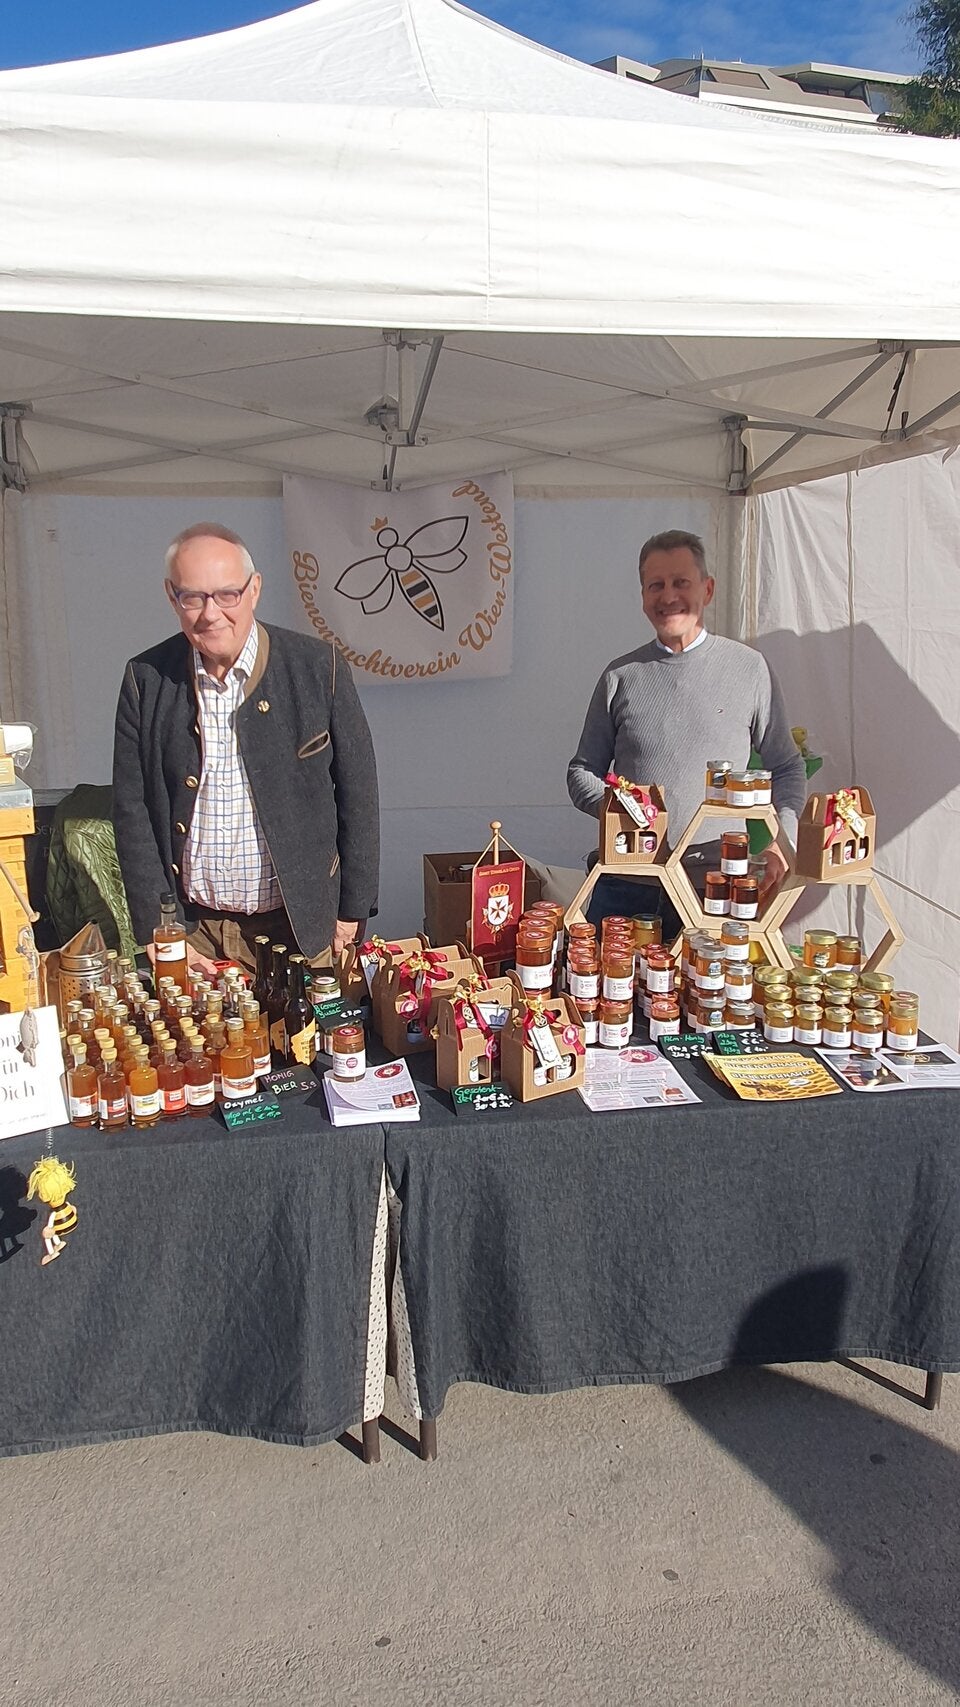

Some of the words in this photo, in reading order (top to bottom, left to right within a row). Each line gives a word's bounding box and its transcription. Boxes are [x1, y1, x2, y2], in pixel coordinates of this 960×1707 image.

[264, 1070, 295, 1083] HONIG
[271, 1081, 298, 1095] BIER
[224, 1095, 264, 1110] Oxymel
